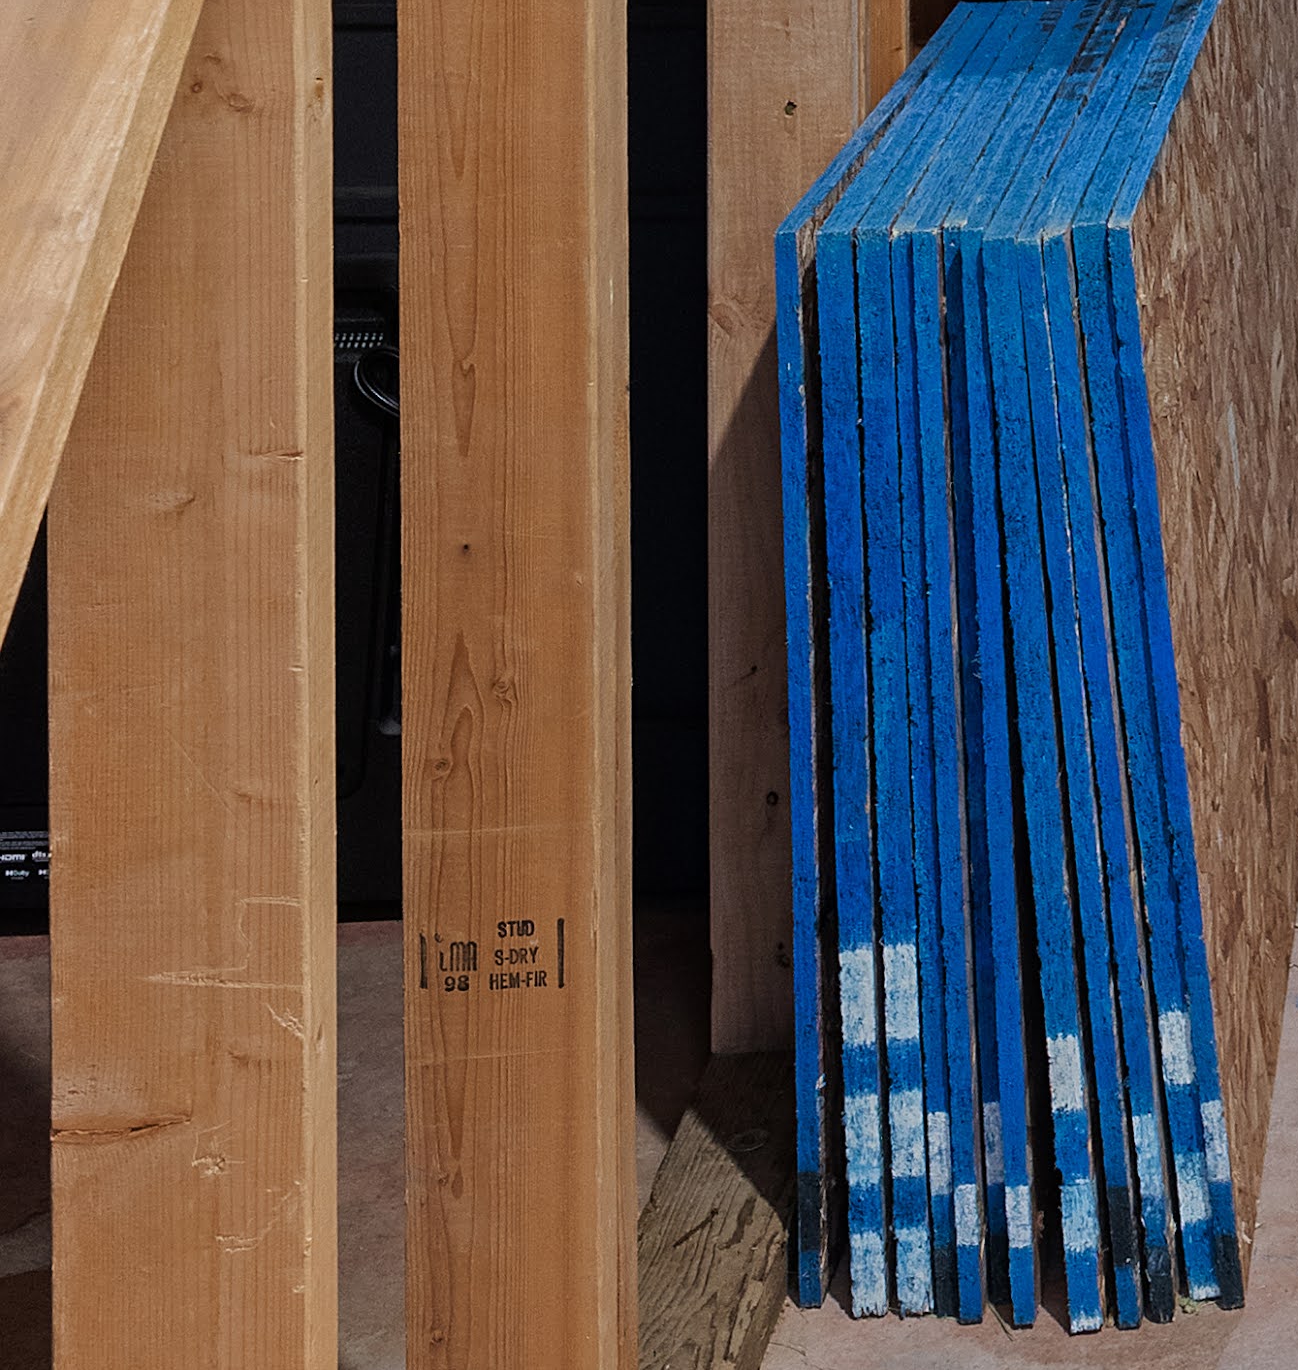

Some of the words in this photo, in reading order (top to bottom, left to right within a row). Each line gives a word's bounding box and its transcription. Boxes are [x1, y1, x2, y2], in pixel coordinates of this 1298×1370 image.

[497, 920, 535, 938] STUD
[494, 947, 539, 966] S-DRY
[444, 976, 470, 992] 98
[489, 971, 547, 990] HEM-FIR
